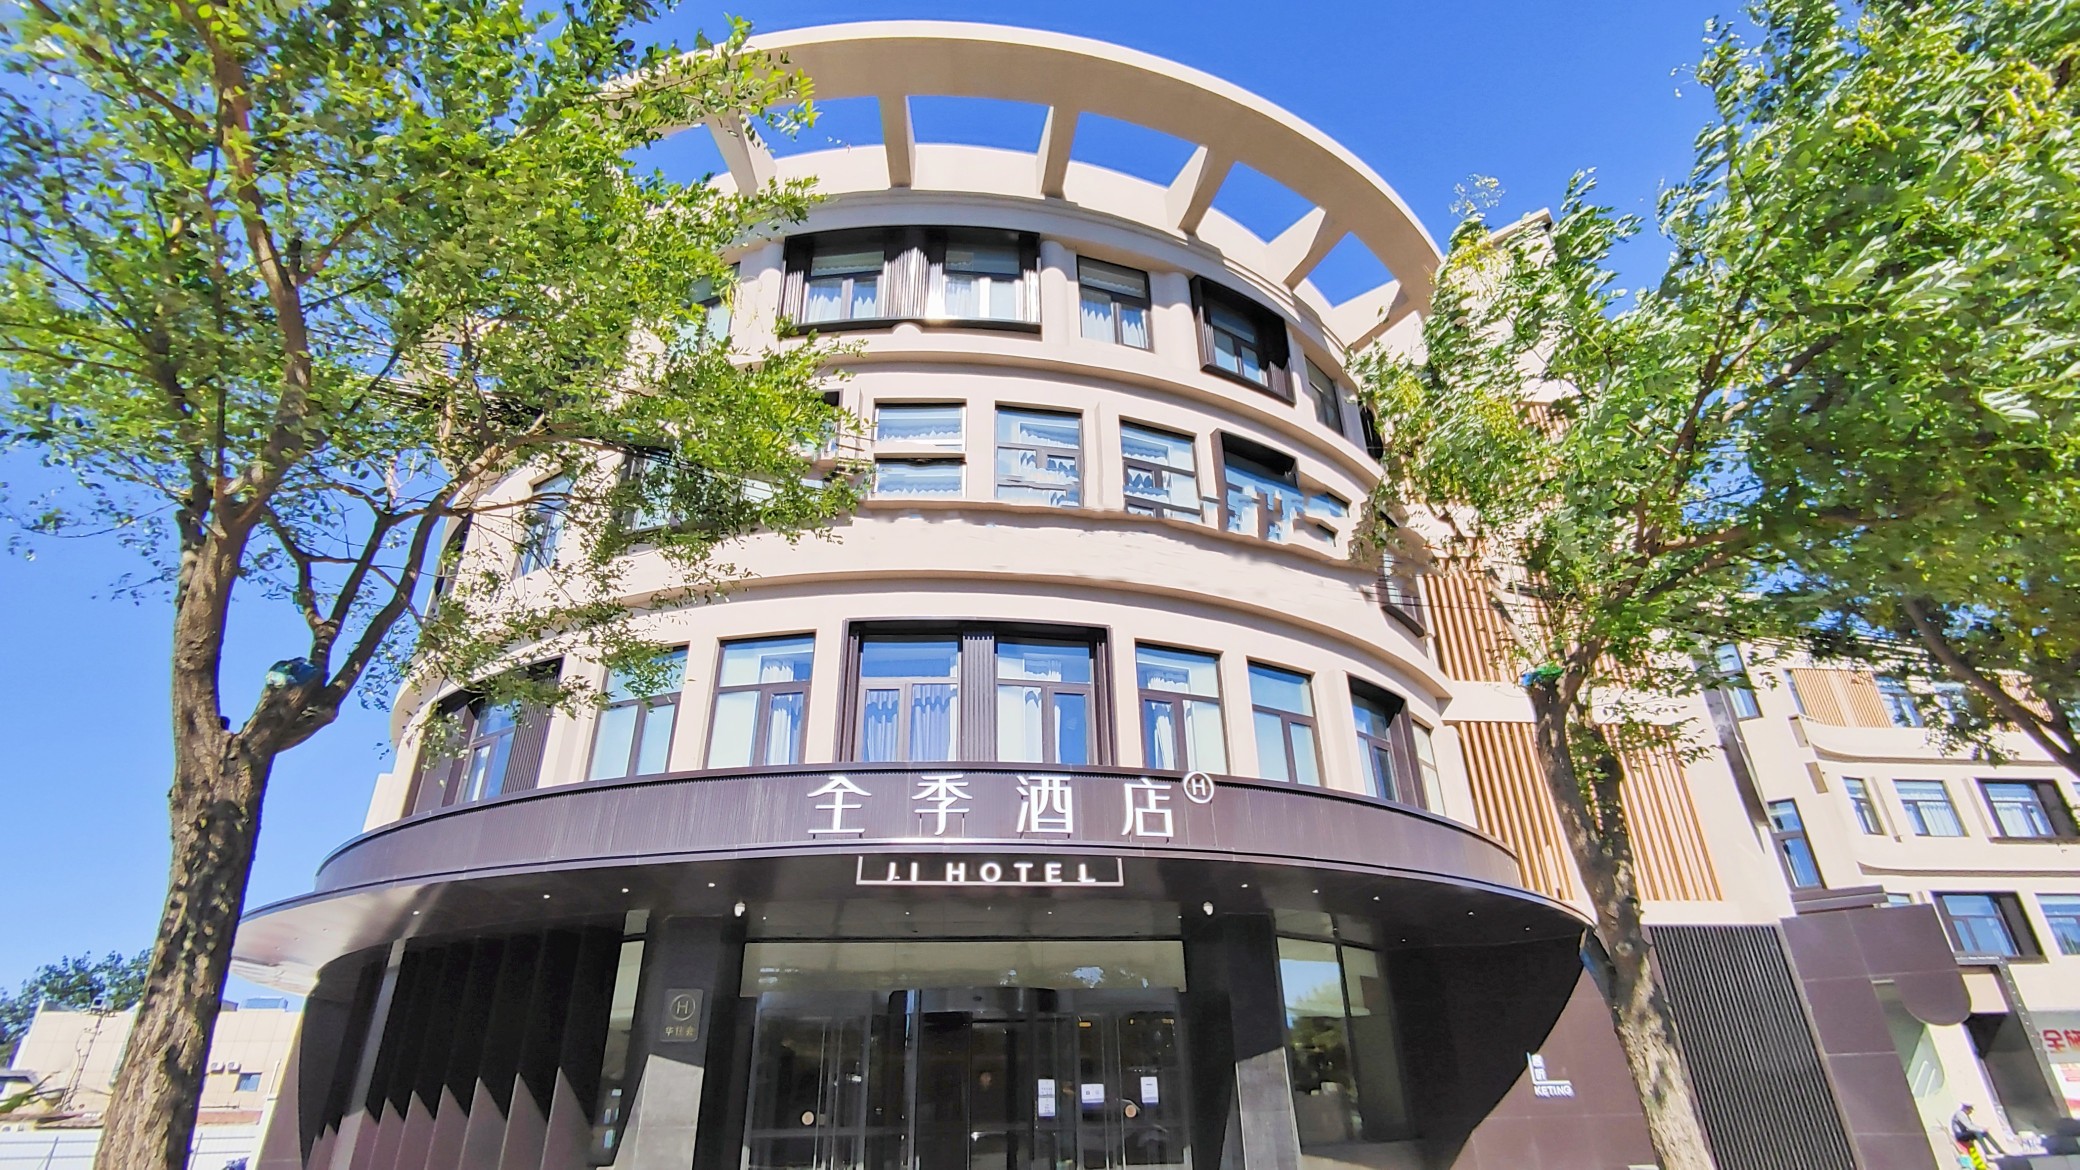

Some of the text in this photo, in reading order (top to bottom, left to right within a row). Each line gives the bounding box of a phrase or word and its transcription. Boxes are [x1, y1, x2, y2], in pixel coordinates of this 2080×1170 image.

[807, 774, 1174, 838] 全季酒店
[886, 862, 1097, 884] JI HOTEL
[1533, 1085, 1575, 1098] KETING
